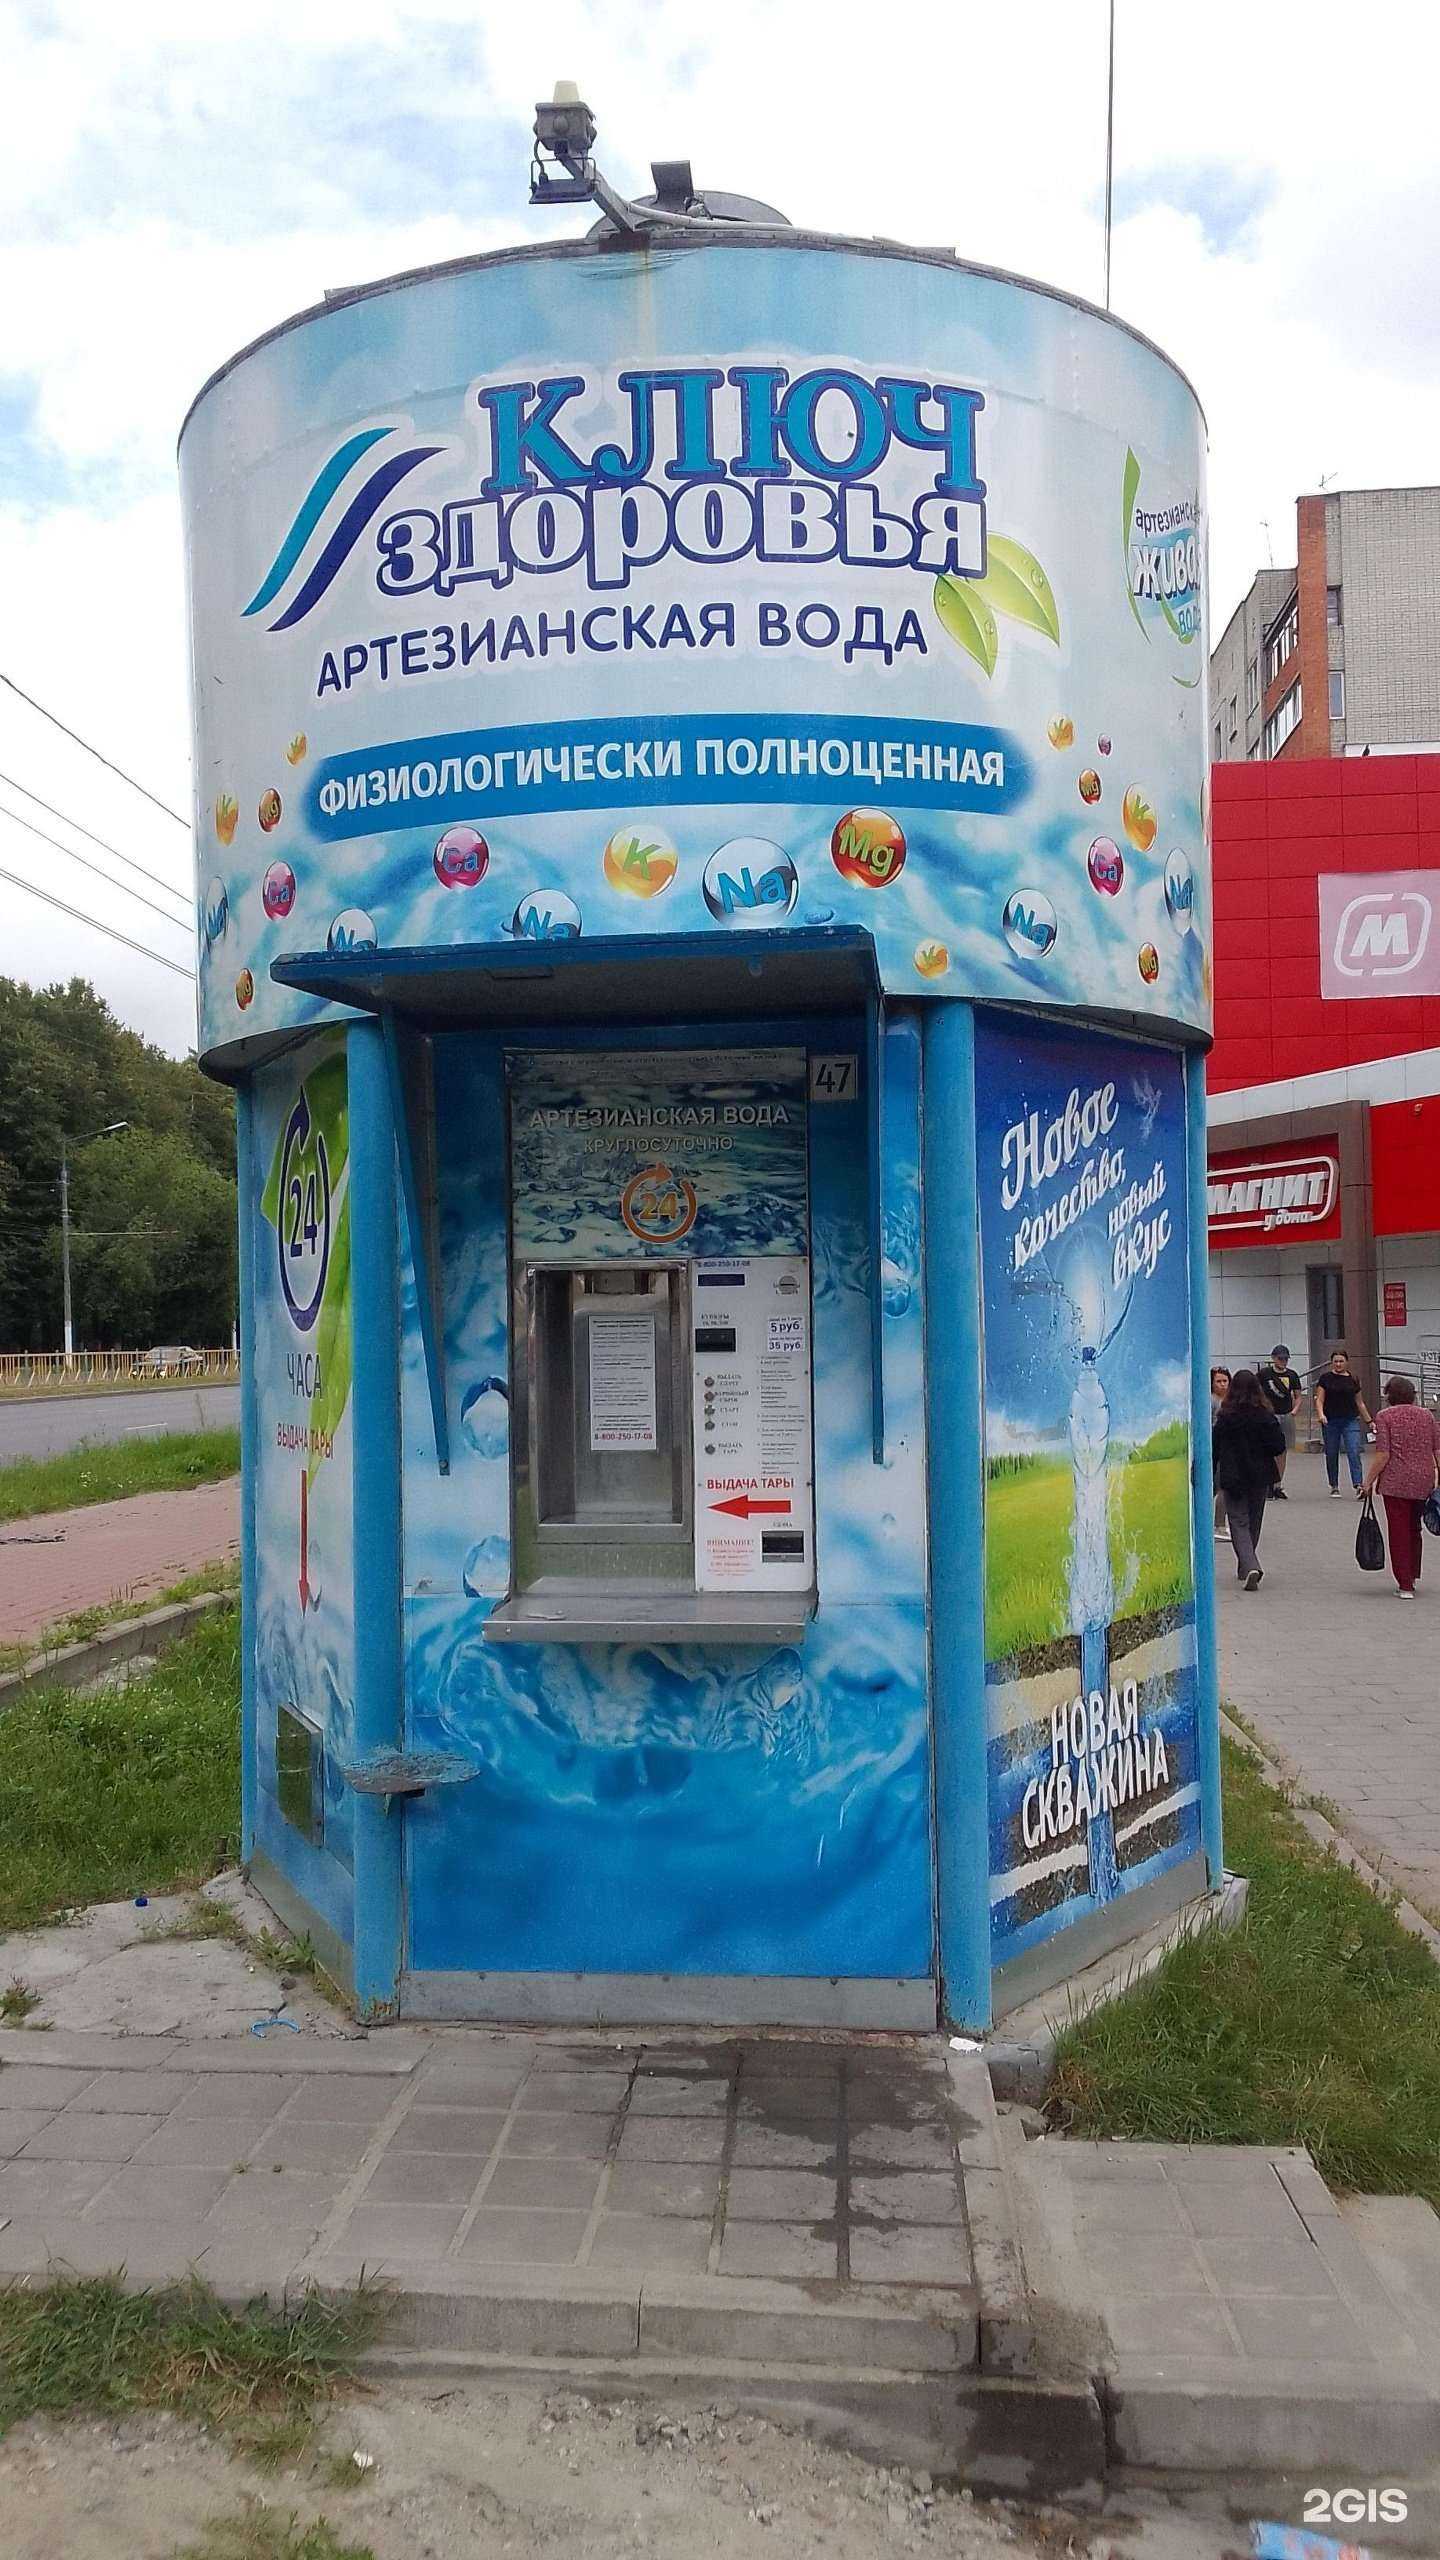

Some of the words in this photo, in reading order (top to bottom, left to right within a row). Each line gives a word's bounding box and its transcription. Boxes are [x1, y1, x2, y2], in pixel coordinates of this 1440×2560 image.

[478, 366, 986, 498] КЛЮЧ
[316, 602, 735, 697] АРТЕЗИАНСКАЯ
[758, 602, 928, 666] ВОДА
[317, 740, 682, 816] ФИЗИОЛОГИЧЕСКИ
[695, 738, 1005, 787] ПОЛНОЦЕННАЯ
[442, 846, 480, 874] Ca
[622, 836, 662, 881] K
[838, 825, 895, 877] Mg
[716, 864, 792, 914] Na
[521, 905, 572, 940] Na
[1010, 902, 1053, 947] Na
[814, 1062, 852, 1095] 47
[527, 1106, 717, 1130] АРТЕЗИАНСКАЯ
[723, 1104, 792, 1126] ВОДА
[583, 1135, 736, 1153] КРУГЛОСУТОЧНО
[1000, 1081, 1120, 1211] Новое
[290, 1172, 318, 1258] 24
[638, 1191, 680, 1222] 24
[1107, 1160, 1168, 1241] новый
[1111, 1208, 1173, 1291] вкус
[768, 1341, 781, 1350] 35
[770, 1322, 778, 1333] 5
[286, 1352, 322, 1399] ЧАСА
[707, 1479, 758, 1490] ВЫДАЧА
[761, 1478, 795, 1489] ТАРЫ
[1051, 1677, 1139, 1769] НОВАЯ
[1022, 1727, 1170, 1849] СКВАЖИНА
